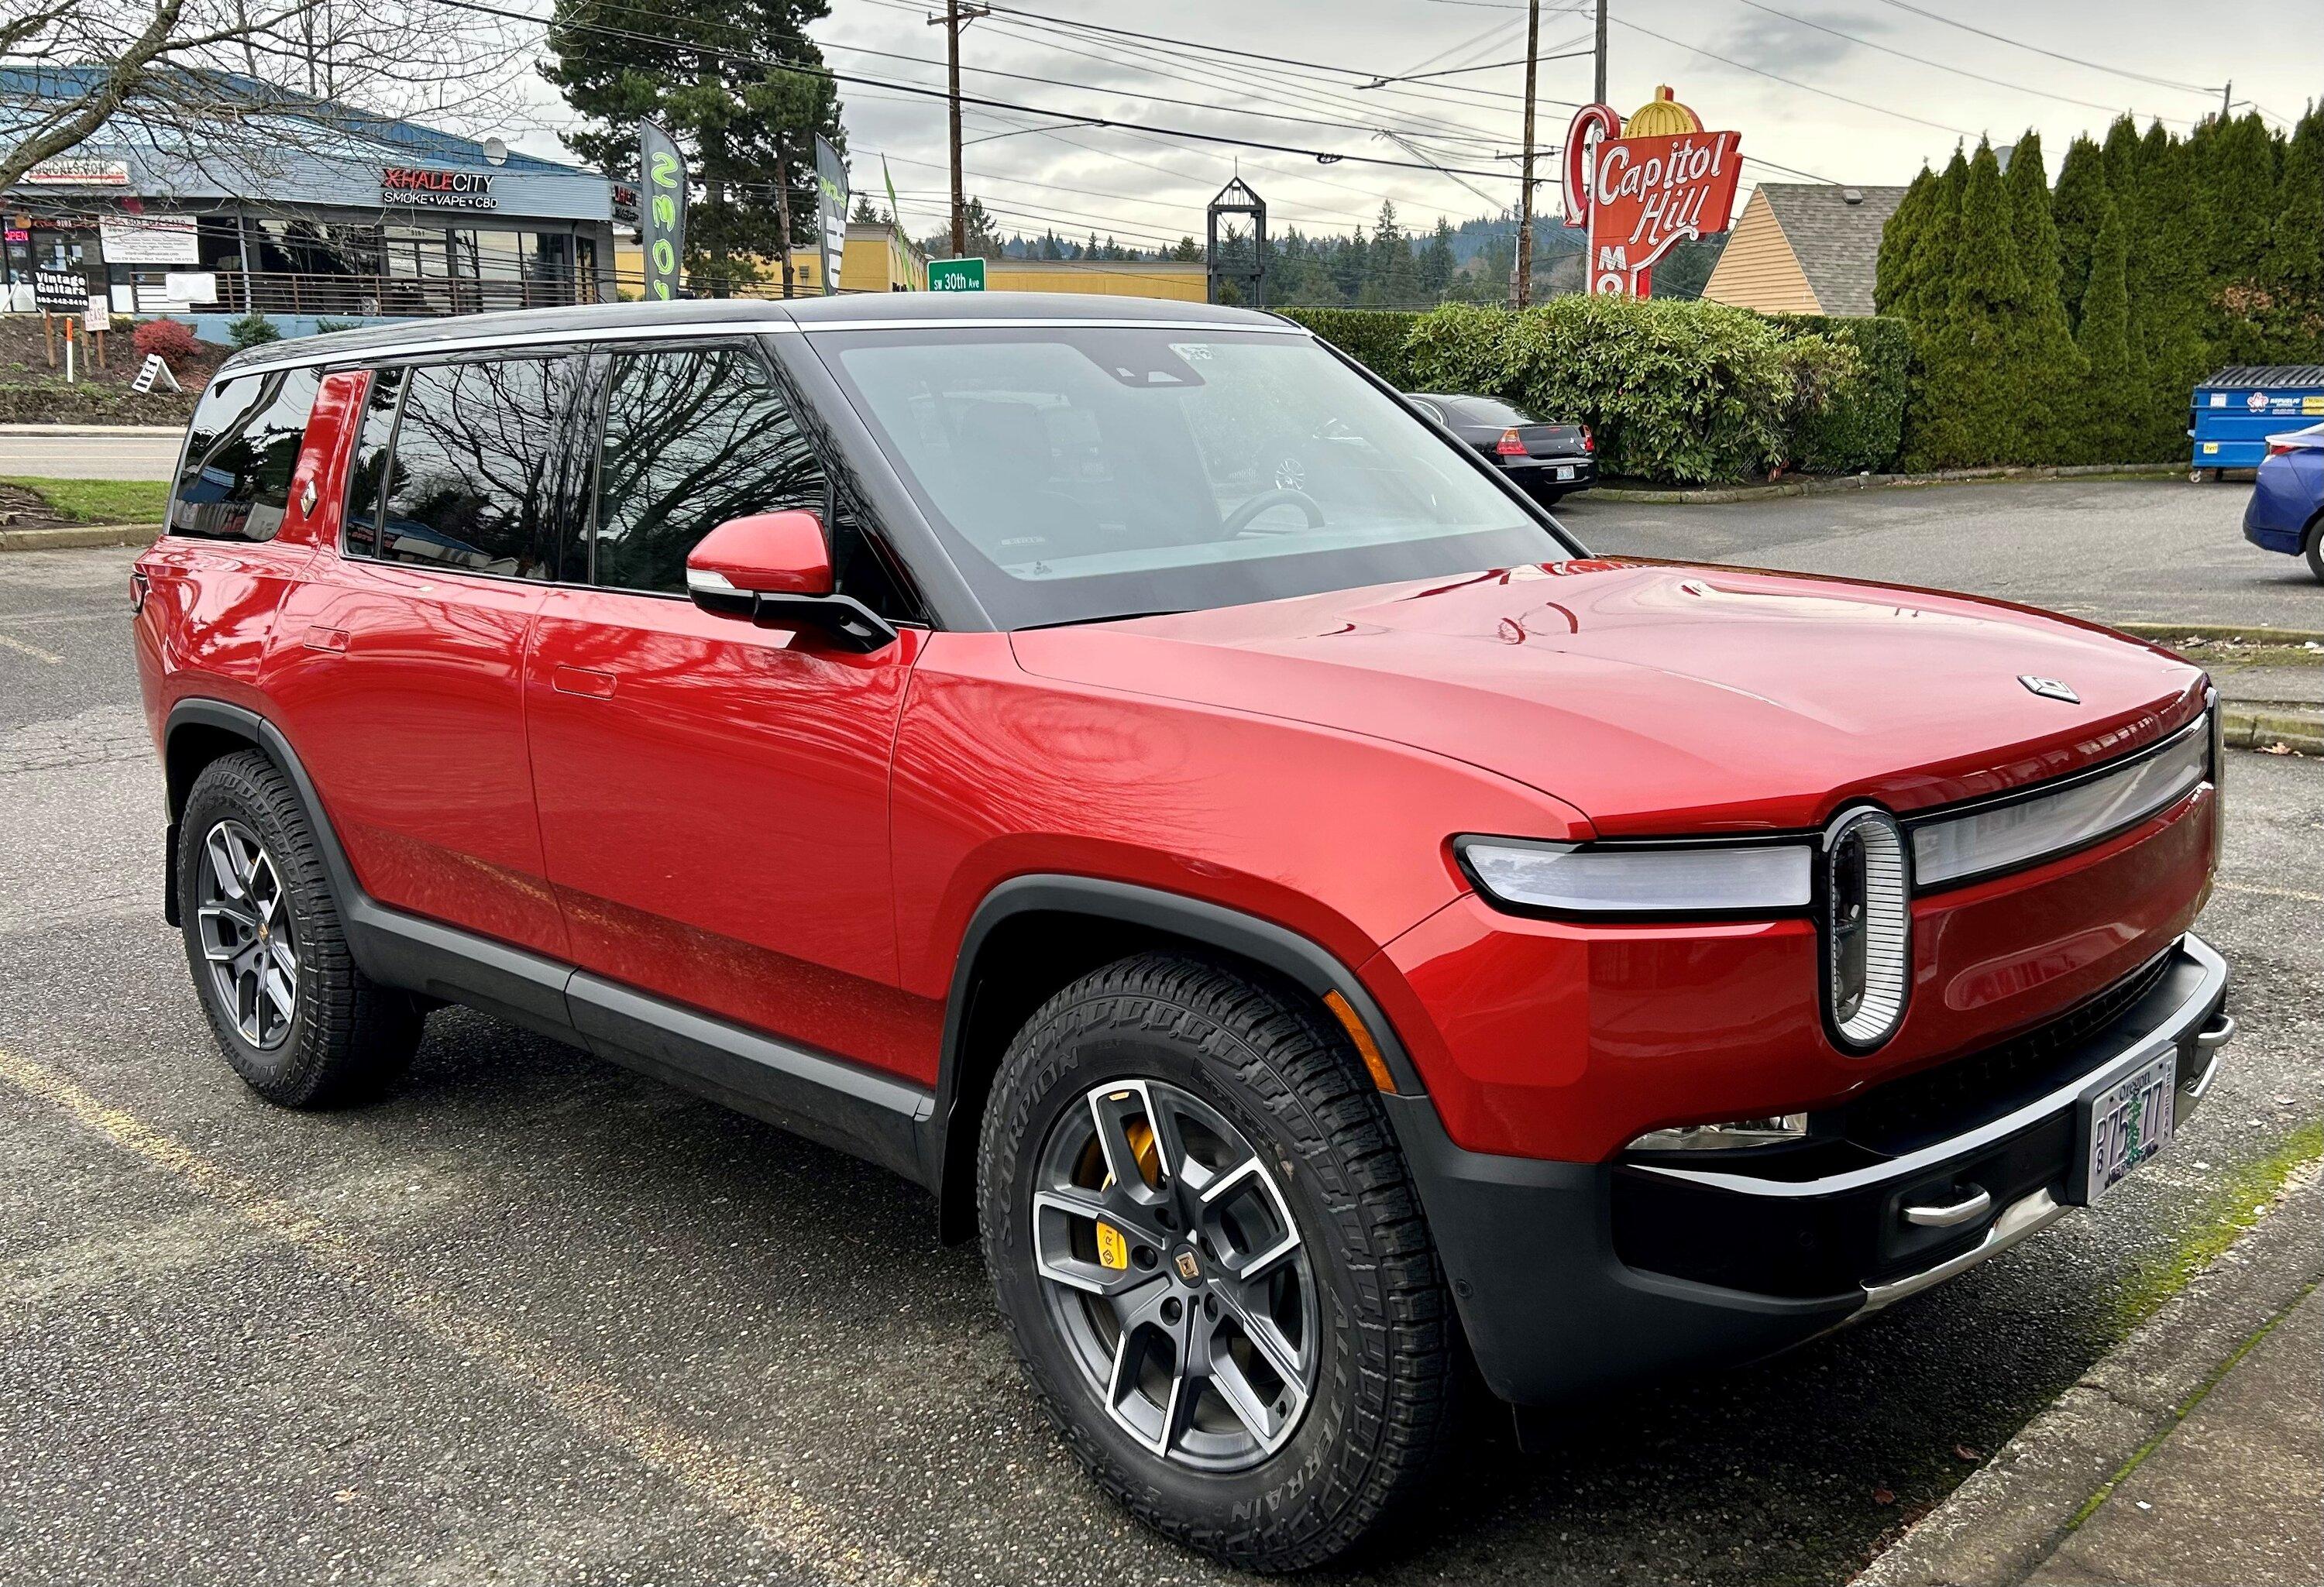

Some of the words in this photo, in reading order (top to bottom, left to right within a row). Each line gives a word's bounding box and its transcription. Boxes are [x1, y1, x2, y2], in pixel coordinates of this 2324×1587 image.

[1597, 133, 1726, 205] Capitol
[384, 191, 428, 205] SMOKE
[435, 194, 466, 207] VAPE
[475, 197, 498, 209] CBD
[1628, 185, 1710, 246] Hill
[5, 231, 29, 241] OPEN
[35, 271, 86, 287] Vintage
[36, 282, 87, 296] Guitars
[933, 279, 943, 290] SW
[944, 273, 966, 290] 30th
[968, 277, 979, 289] Ave
[2119, 1071, 2150, 1101] Oregon
[998, 1046, 1079, 1247] SCORPION
[1231, 1396, 1345, 1523] TERRAIN
